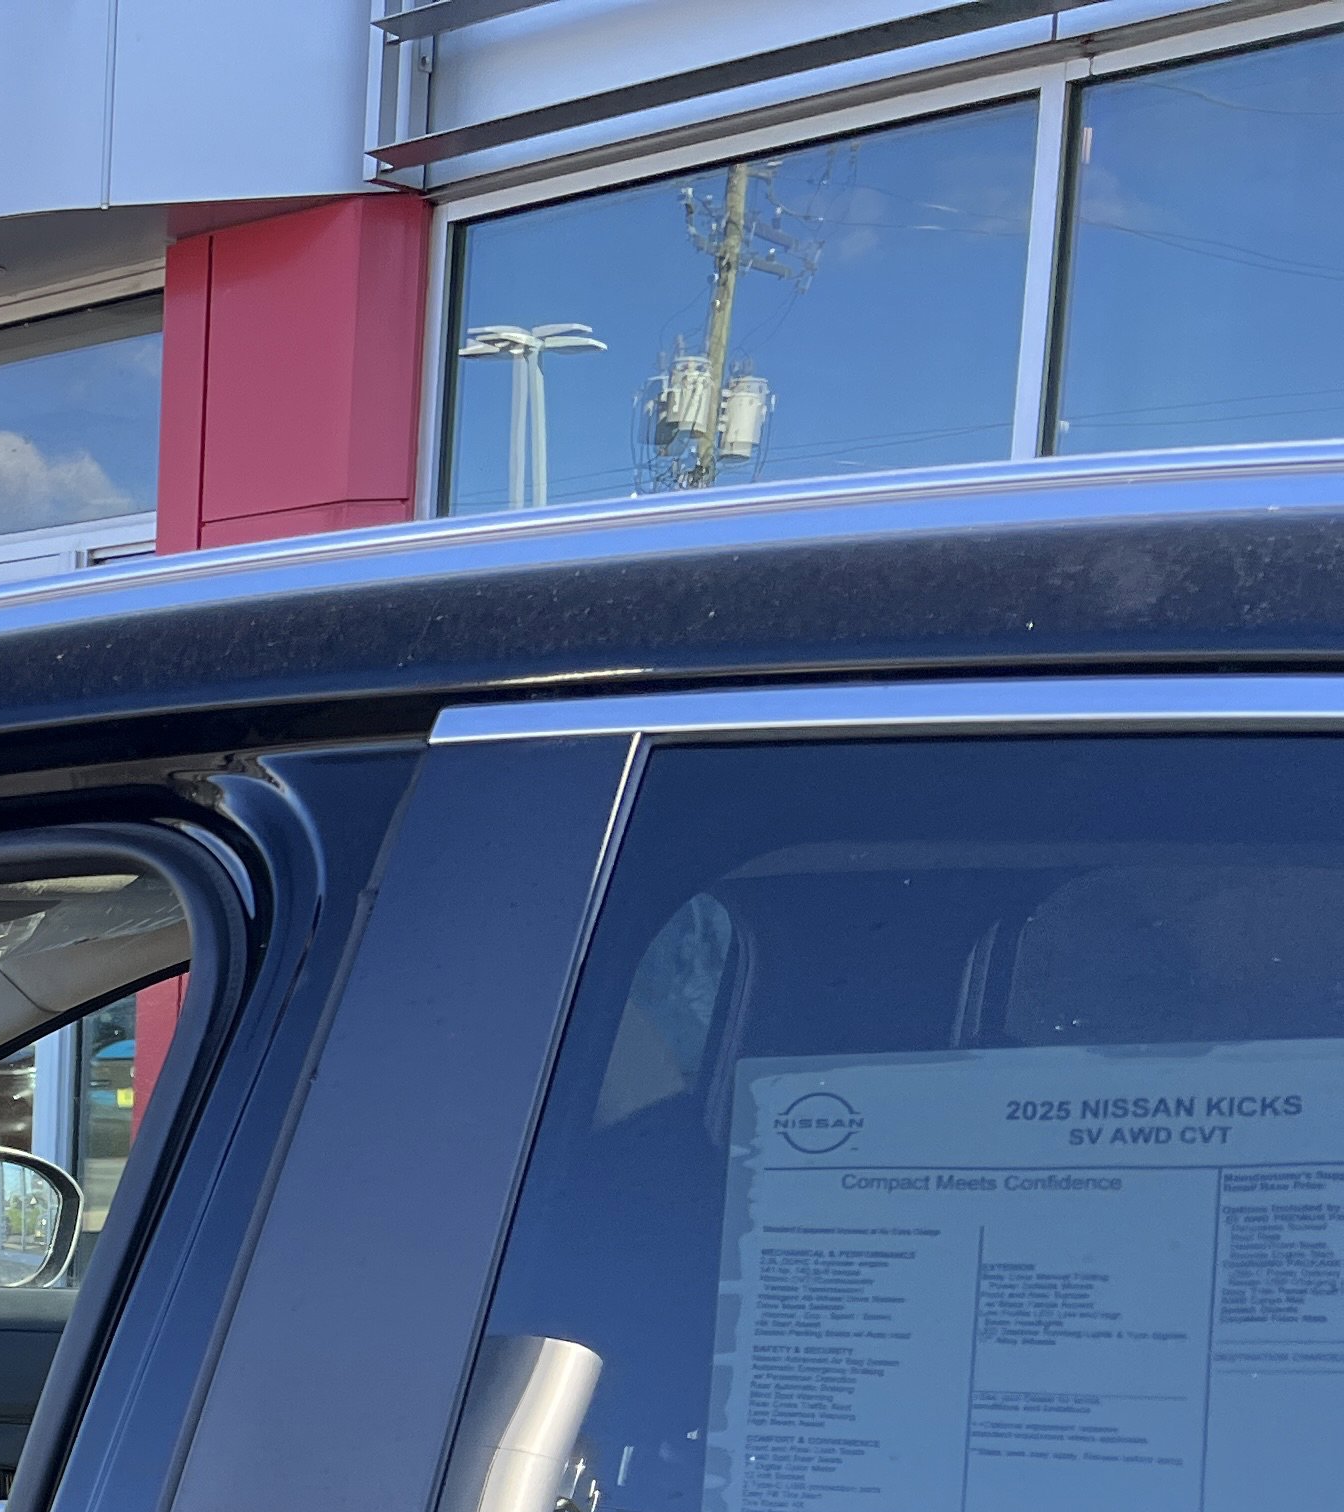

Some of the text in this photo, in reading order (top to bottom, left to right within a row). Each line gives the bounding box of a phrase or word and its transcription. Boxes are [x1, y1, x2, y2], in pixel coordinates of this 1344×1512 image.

[1005, 1094, 1304, 1121] 2025 NISSAN KICKS
[773, 1118, 865, 1129] NISSAN
[1068, 1125, 1232, 1146] SV AWD CVT
[841, 1174, 1123, 1194] Compact Meets Confidence
